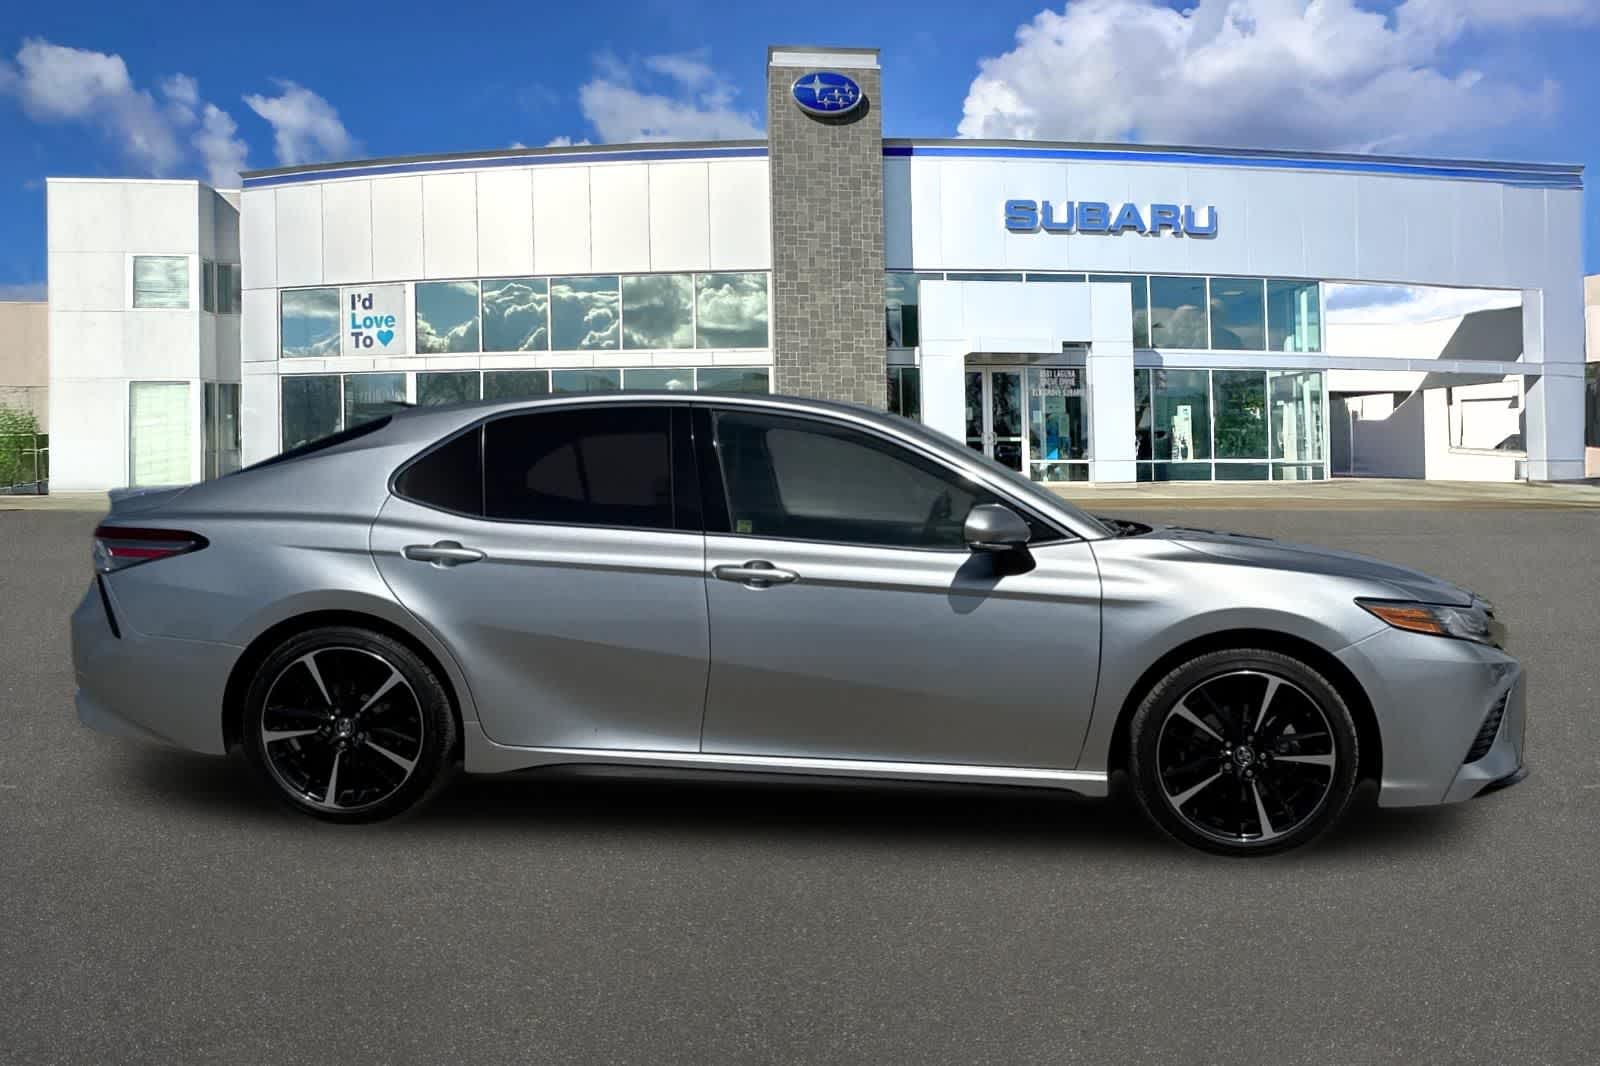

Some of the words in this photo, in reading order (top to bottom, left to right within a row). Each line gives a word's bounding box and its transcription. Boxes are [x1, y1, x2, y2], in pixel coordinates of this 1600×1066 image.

[1005, 199, 1218, 238] SUBARU
[351, 293, 373, 310] I'd
[351, 312, 396, 329] Love
[351, 332, 374, 348] To
